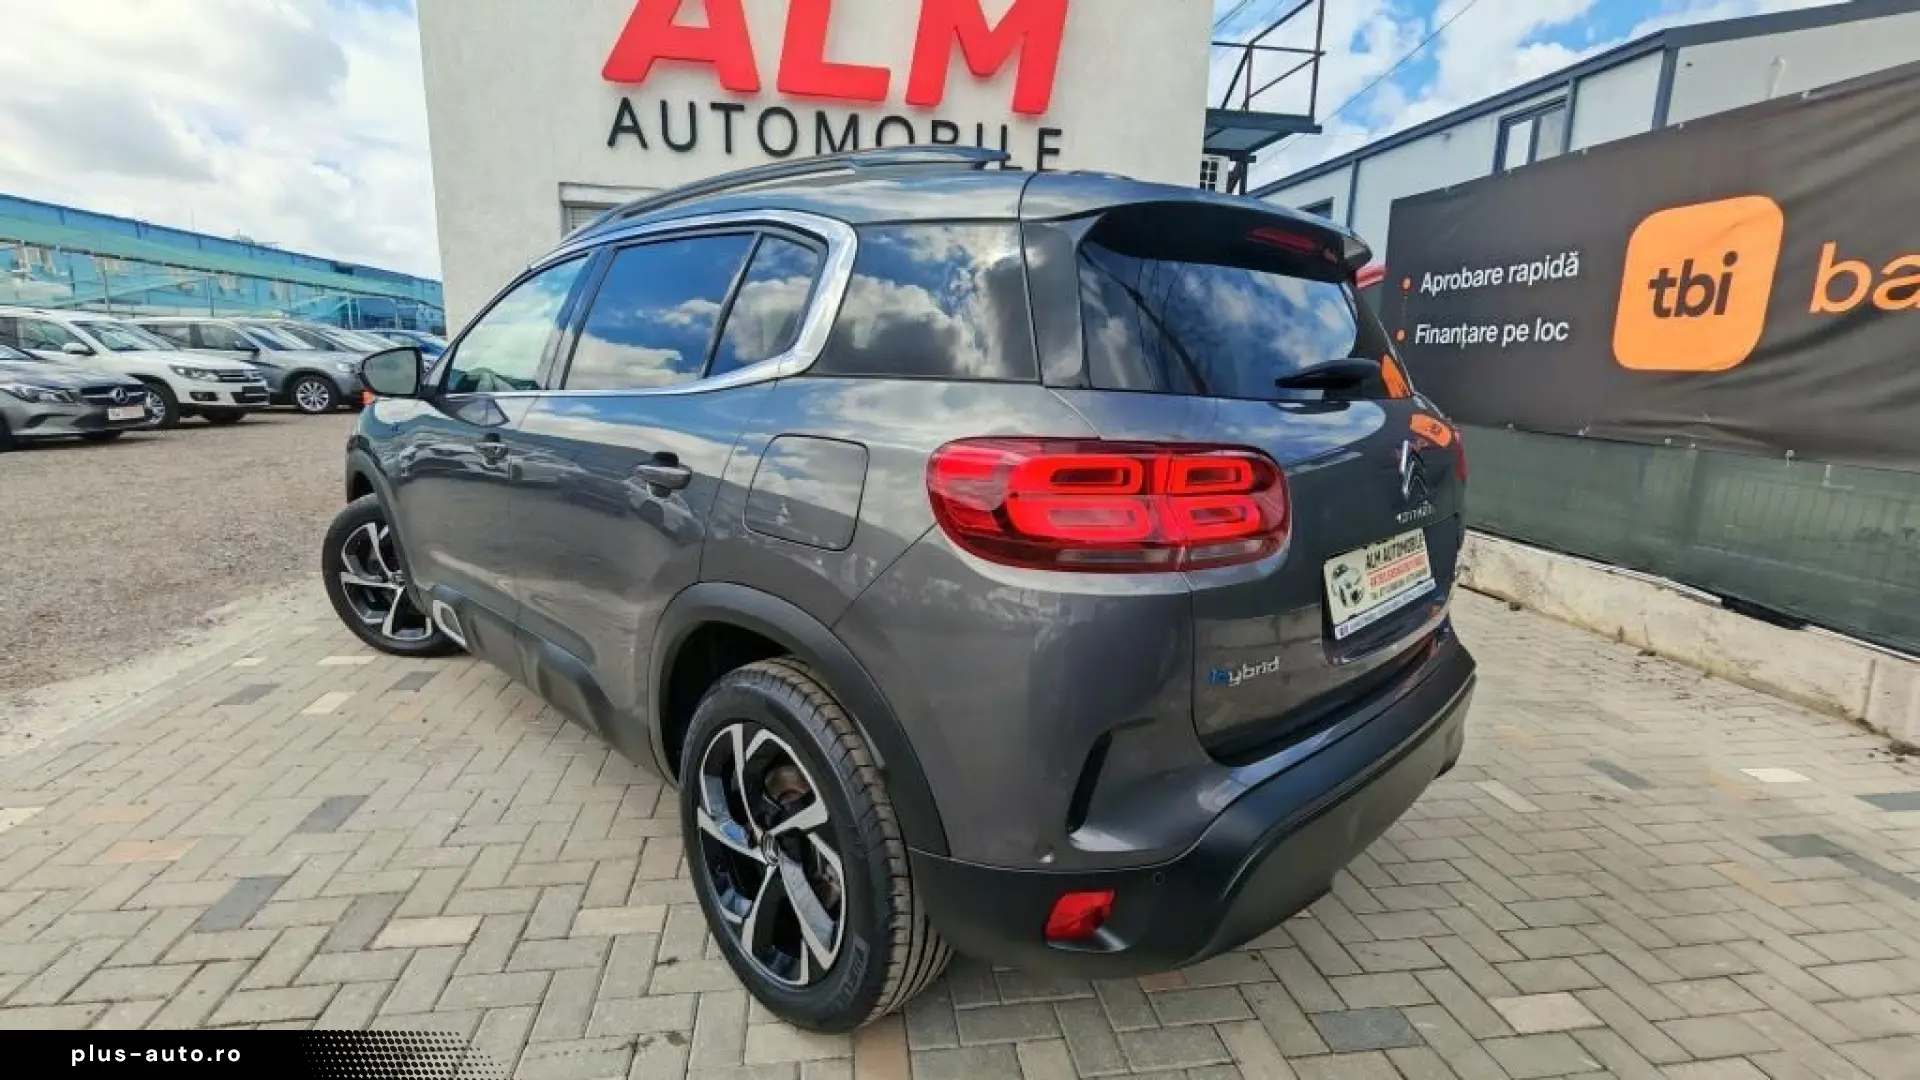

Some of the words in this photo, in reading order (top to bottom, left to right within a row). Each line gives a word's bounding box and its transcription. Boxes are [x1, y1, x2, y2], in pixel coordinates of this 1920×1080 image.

[601, 0, 1070, 117] ALM
[1419, 266, 1504, 297] Aprobare
[1508, 251, 1580, 287] rapidă
[1648, 251, 1740, 318] tbi
[1808, 241, 1920, 313] ba
[1415, 322, 1499, 350] Finanțare
[1501, 323, 1530, 347] pe
[1534, 316, 1570, 342] loc
